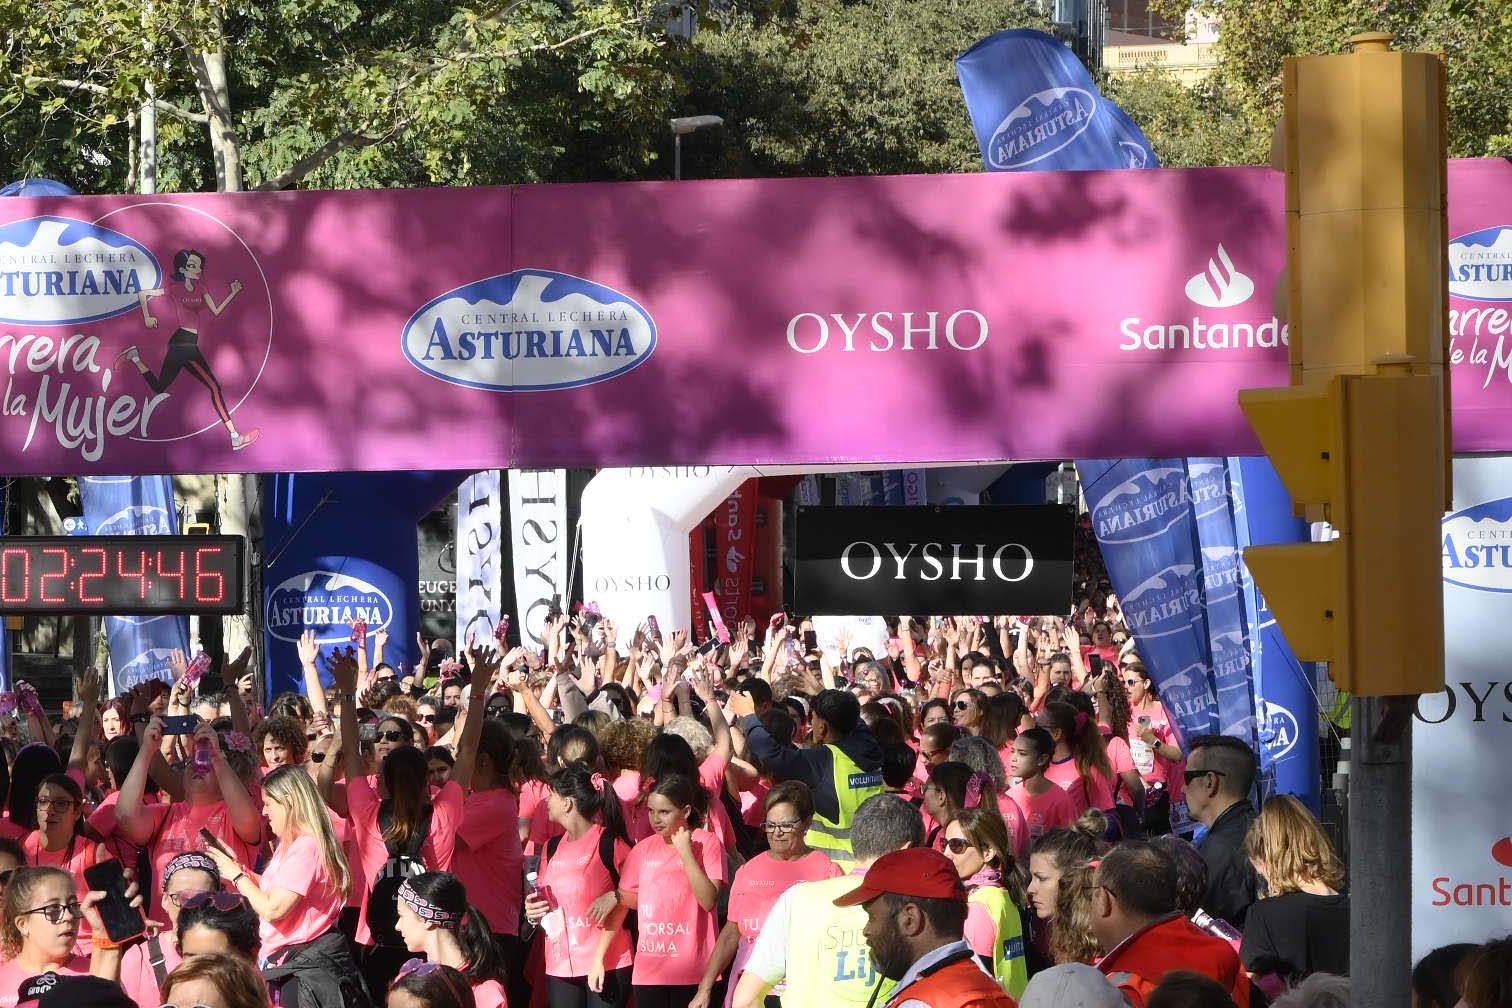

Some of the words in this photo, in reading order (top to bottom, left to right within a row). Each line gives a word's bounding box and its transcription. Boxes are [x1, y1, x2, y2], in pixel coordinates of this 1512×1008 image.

[64, 252, 136, 265] LECHERA
[460, 310, 541, 326] CENTRAL
[547, 309, 630, 324] LECHERA
[421, 316, 638, 363] ASTURIANA
[785, 308, 990, 356] OYSHO
[1120, 314, 1289, 351] Santand
[2, 376, 27, 417] la
[21, 368, 172, 462] Mujer
[1467, 530, 1512, 540] CENT
[839, 540, 1035, 583] OYSHO
[1, 548, 224, 603] 02:24:46
[593, 574, 671, 593] OYSHO
[329, 595, 379, 604] LECHERA
[270, 598, 383, 628] ASTURIANA
[743, 918, 760, 931] TU
[640, 939, 678, 953] SUMA
